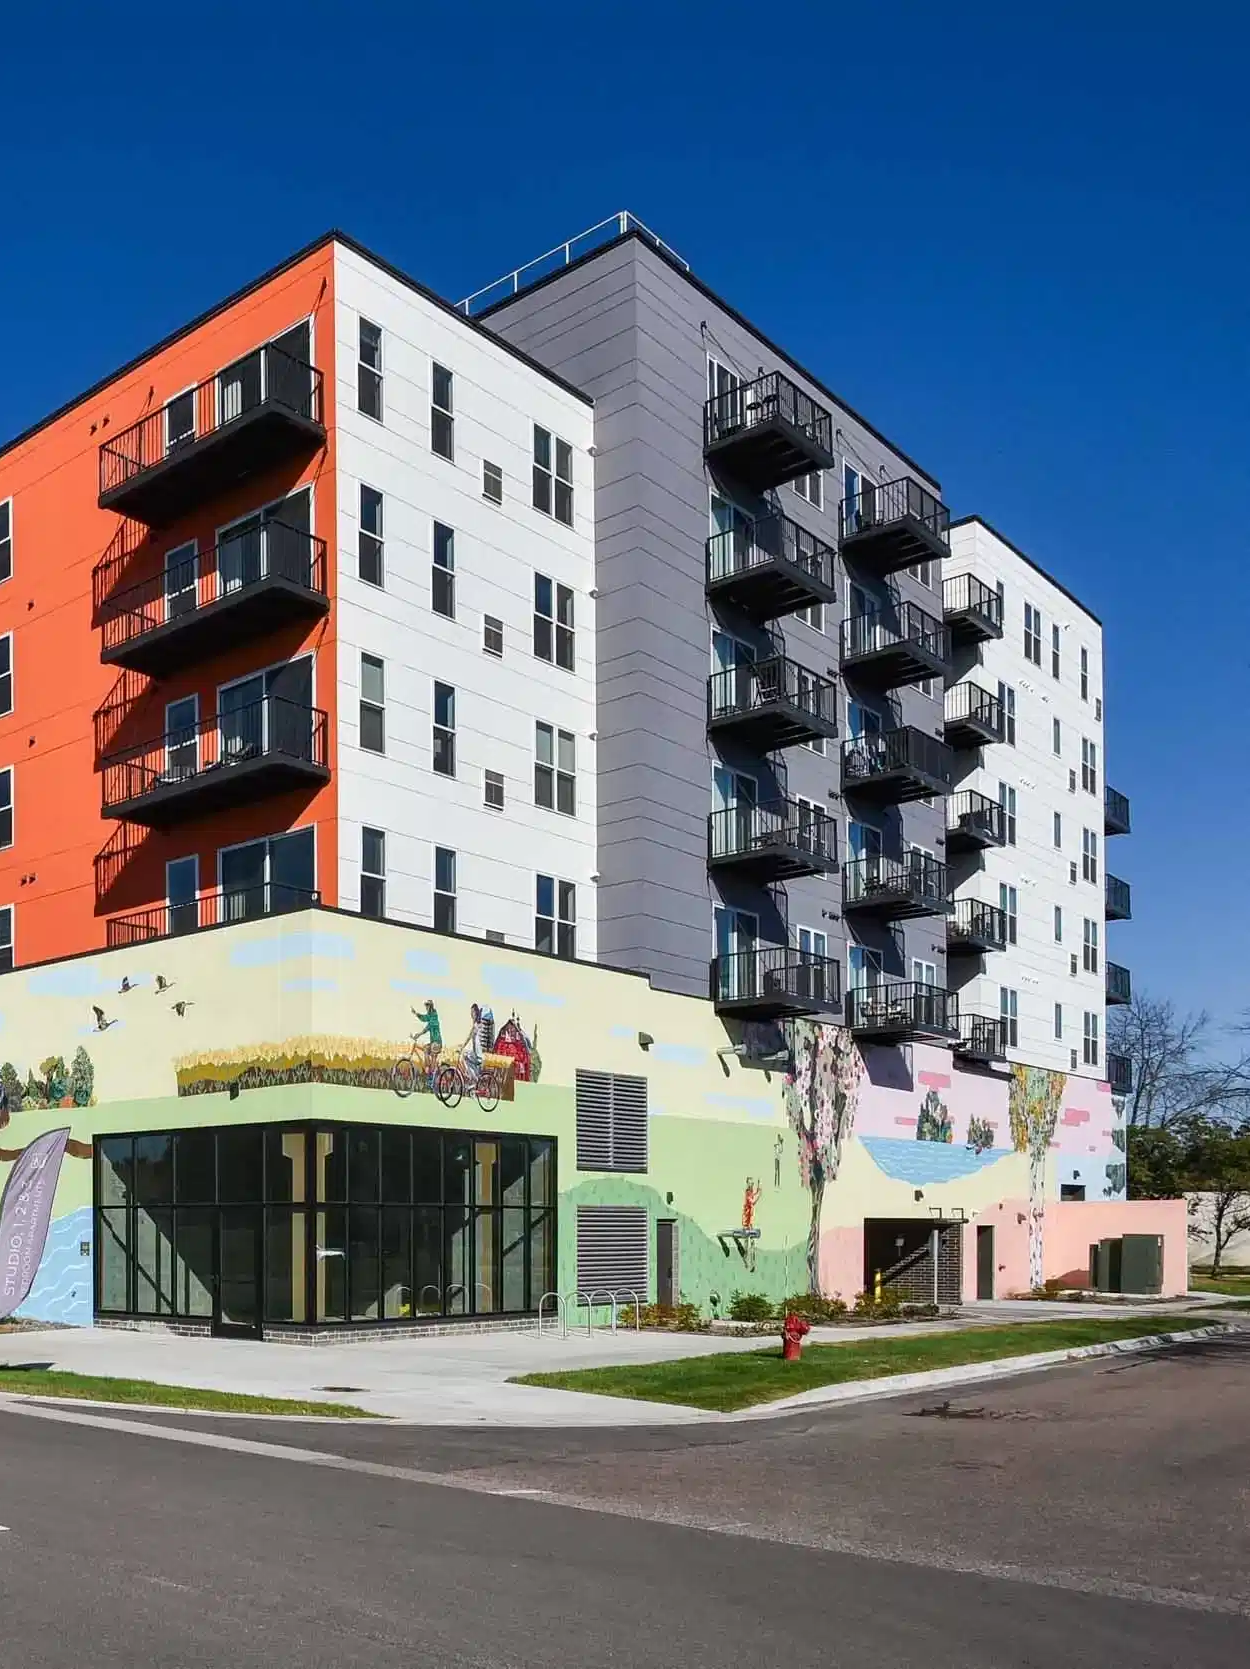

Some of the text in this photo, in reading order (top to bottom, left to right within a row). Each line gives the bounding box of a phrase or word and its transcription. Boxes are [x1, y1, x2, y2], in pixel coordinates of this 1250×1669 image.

[19, 1191, 30, 1202] &
[14, 1206, 27, 1216] 2
[4, 1232, 25, 1297] STUDIO,
